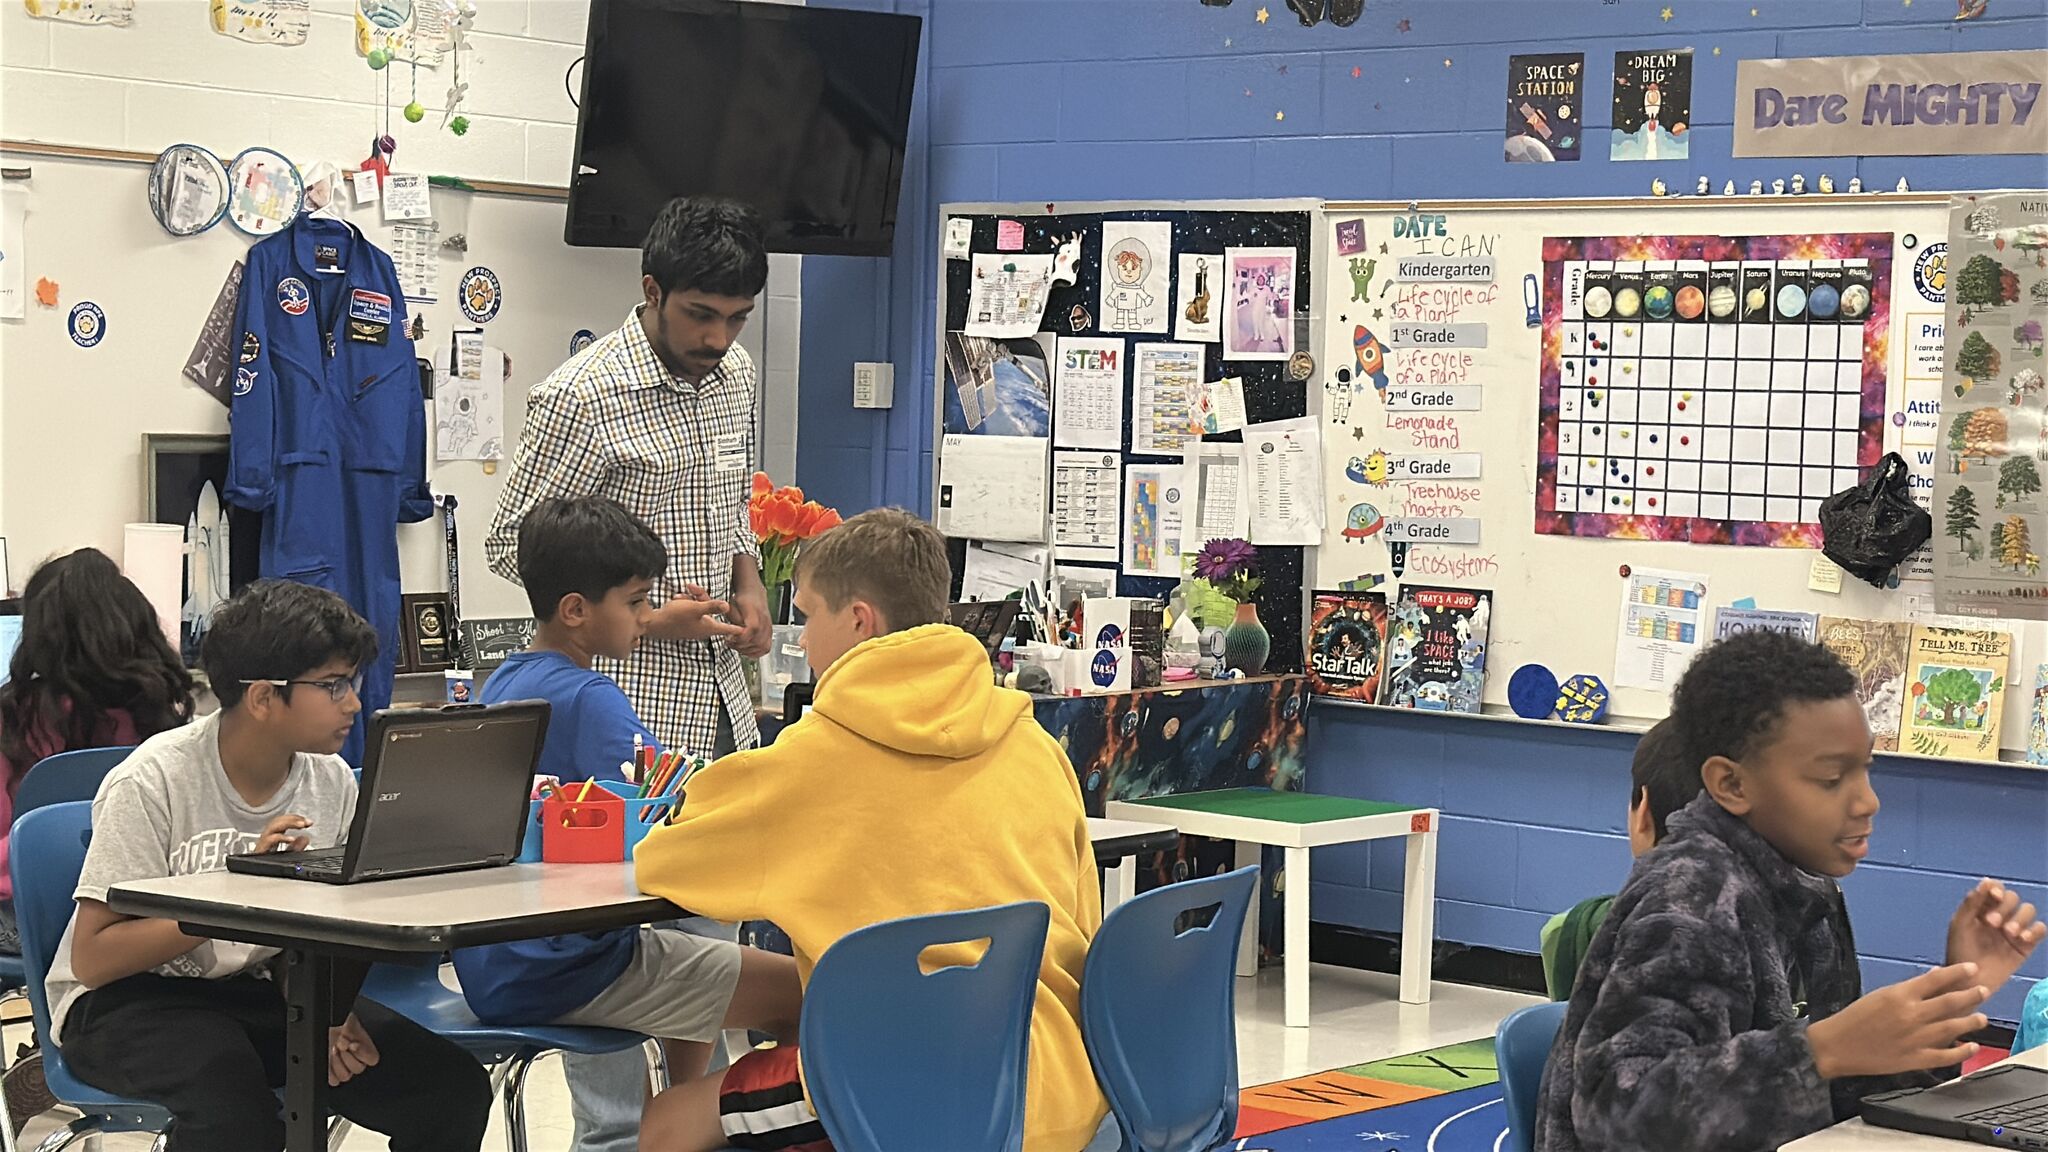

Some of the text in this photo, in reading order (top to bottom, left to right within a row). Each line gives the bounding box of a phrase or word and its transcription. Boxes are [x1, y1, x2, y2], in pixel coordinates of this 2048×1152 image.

[1634, 54, 1677, 69] DREAM
[1526, 65, 1565, 80] SPACE
[1642, 69, 1666, 83] BIG
[1517, 80, 1574, 96] STATION
[1753, 82, 2042, 130] Dare MIGHTY
[1393, 214, 1447, 238] DATE
[1414, 238, 1434, 255] I
[1914, 251, 1929, 272] NEW
[1398, 262, 1490, 280] Kindergarten
[1586, 272, 1612, 280] Mercury
[1619, 273, 1639, 281] Venus
[1710, 271, 1734, 280] Jupiter
[1746, 270, 1768, 278] Saturn
[1781, 269, 1805, 277] Uranus
[461, 271, 474, 289] NEW
[1571, 268, 1581, 306] Grade
[1398, 284, 1430, 305] Life
[1477, 283, 1498, 304] of
[1397, 307, 1409, 319] a
[1413, 328, 1456, 343] Grade
[1570, 332, 1578, 343] K
[1065, 349, 1117, 371] STEM
[1396, 350, 1429, 367] Life
[1396, 369, 1410, 385] of
[1416, 372, 1426, 384] a
[1411, 391, 1454, 406] Grade
[1566, 401, 1573, 412] 2
[1907, 400, 1941, 414] Attit
[945, 437, 962, 446] MAY
[1563, 433, 1570, 444] 3
[1409, 460, 1451, 474] Grade
[1907, 474, 1934, 488] Cho
[1407, 523, 1450, 538] Grade
[1418, 594, 1443, 603] THAT'S
[1454, 597, 1473, 605] JOB?
[1388, 602, 1396, 615] 5
[476, 622, 504, 641] Shoot
[1426, 629, 1432, 642] I
[1830, 626, 1863, 641] BEES
[1098, 638, 1121, 649] NASA
[1423, 643, 1455, 658] SPACE
[1919, 638, 1945, 650] TELL
[1970, 642, 1998, 654] TREE
[480, 649, 505, 660] Land
[1093, 663, 1115, 675] NASA
[378, 792, 401, 801] acer
[1386, 1055, 1499, 1079] X
